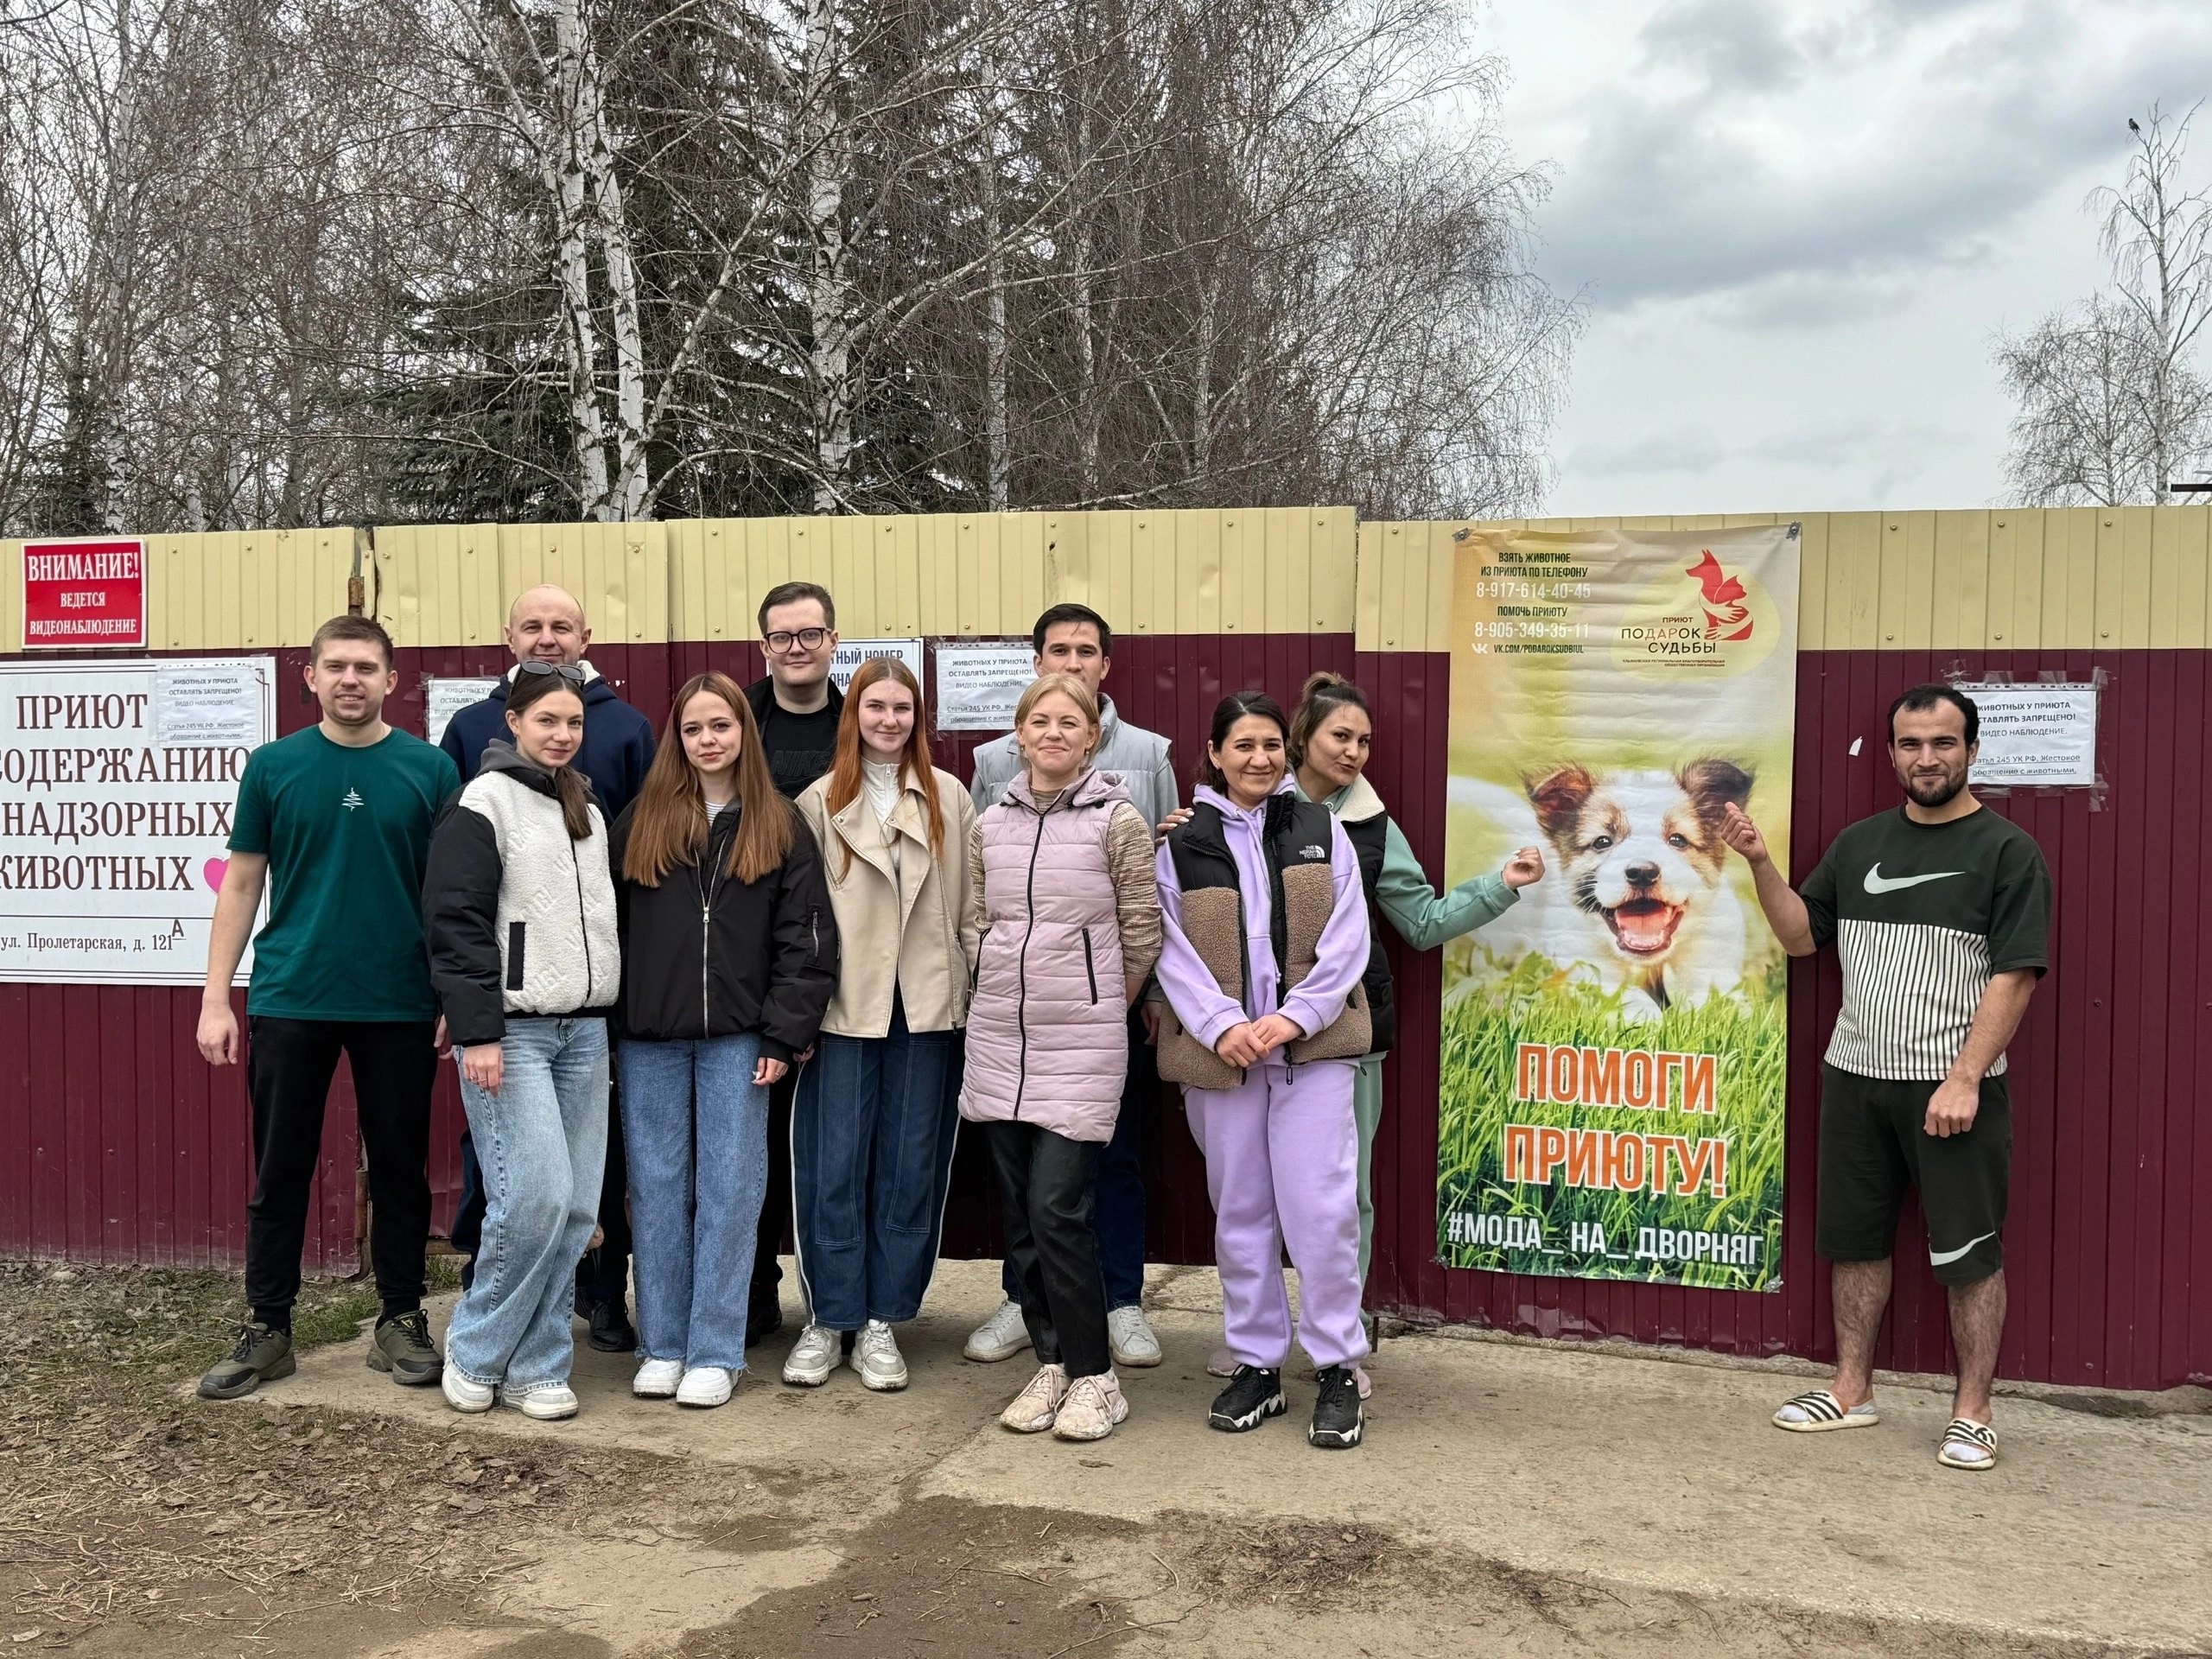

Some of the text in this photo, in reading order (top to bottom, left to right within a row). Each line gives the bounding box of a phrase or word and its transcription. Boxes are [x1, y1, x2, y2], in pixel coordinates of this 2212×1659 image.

[1498, 552, 1571, 563] ВЗЯТЬ ЖИВОТНОЕ
[27, 551, 139, 582] ВНИМАНИЕ!
[1481, 567, 1588, 577] ИЗ ПРИЮТА ПО ТЕЛЕФОНУ
[1476, 582, 1591, 599] 8-917-614-40-45
[60, 592, 106, 609] ВЕДЕТСЯ
[1497, 606, 1568, 617] ПОМОЧЬ ПРИЮТУ
[29, 619, 137, 637] ВИДЕОНАБЛЮДЕНИЕ
[1474, 621, 1589, 638] 8-905-349-35-11
[1622, 627, 1700, 640] ПОДАРОК
[1648, 642, 1716, 655] СУДЬБЫ
[16, 694, 148, 729] ПРИЮТ
[2022, 714, 2076, 722] ЗАПРЕЩЕНО!
[2009, 728, 2068, 736] НАБЛЮДЕНИЕ.
[0, 747, 250, 791] ОДЕРЖАНИЮ
[0, 938, 21, 950] ул.
[28, 932, 126, 952] Пролетарская,
[133, 938, 145, 952] д.
[1517, 1044, 1718, 1115] ПОМОГИ
[1503, 1124, 1727, 1199] ПРИЮТУ!
